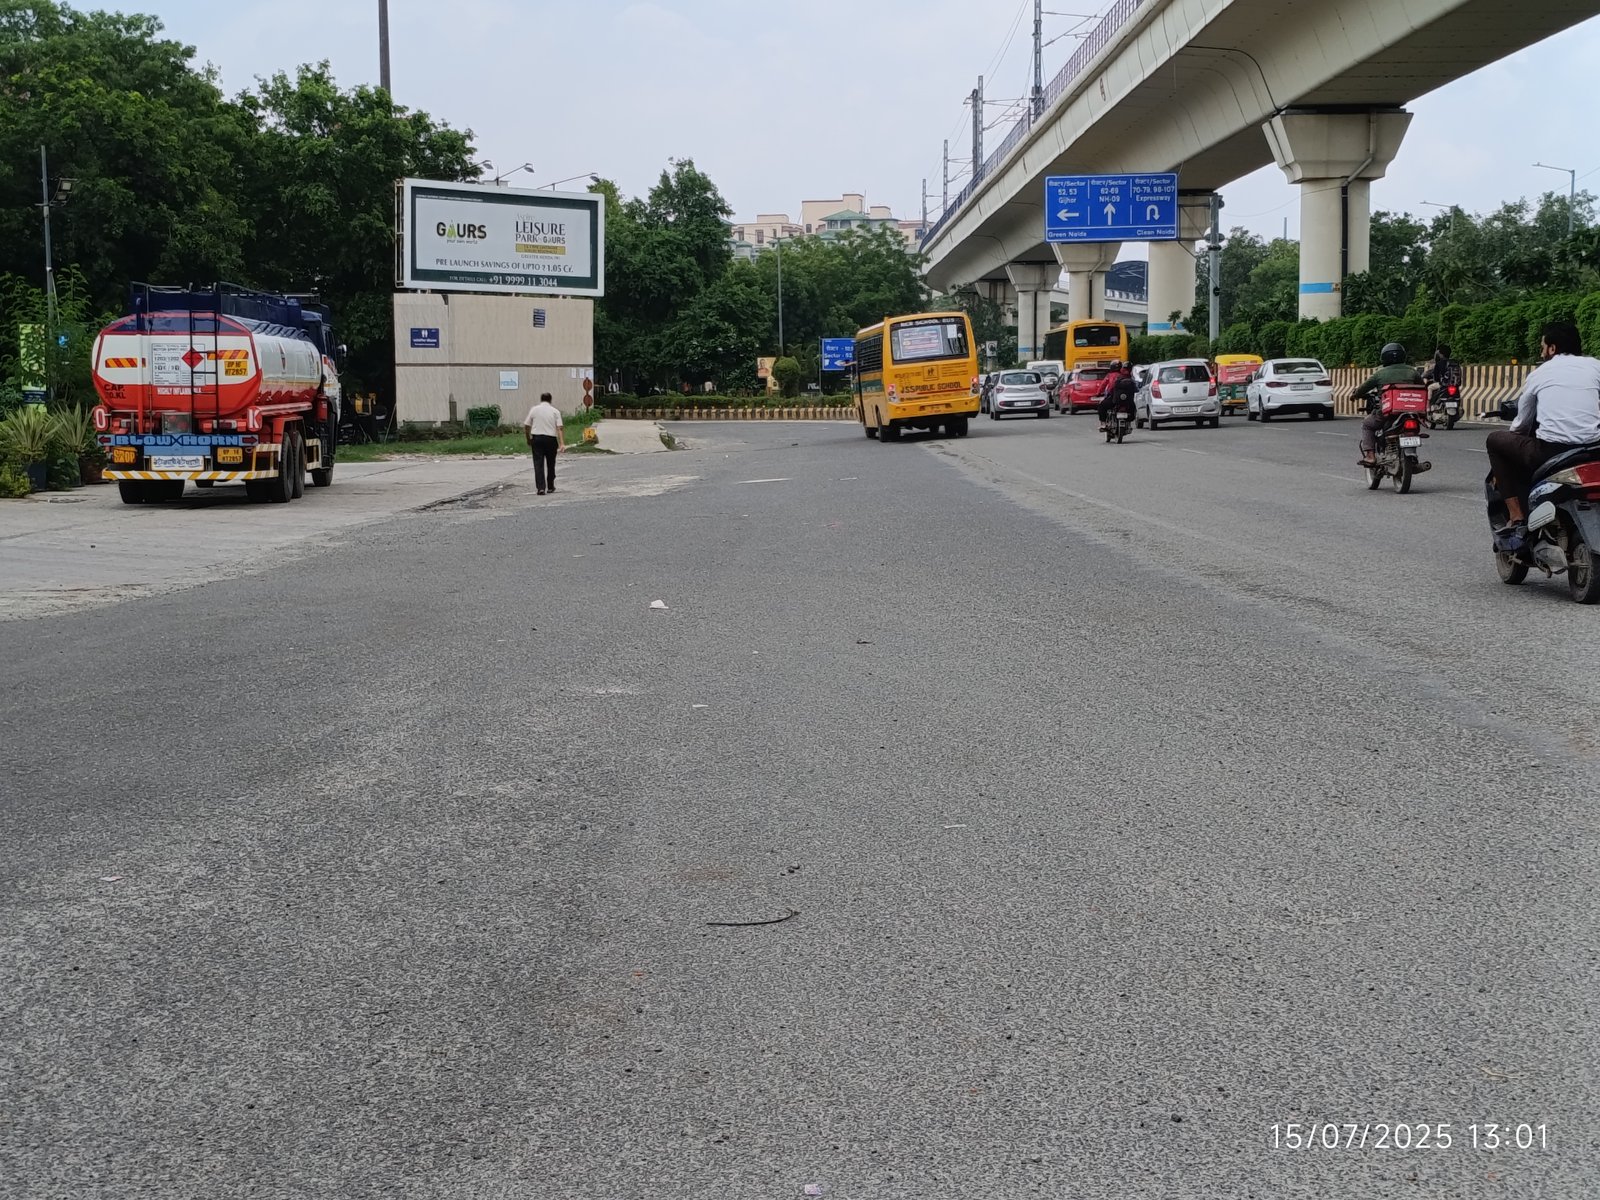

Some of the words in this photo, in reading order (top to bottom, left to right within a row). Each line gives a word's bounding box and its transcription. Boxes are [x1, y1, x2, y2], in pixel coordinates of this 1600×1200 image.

[1099, 195, 1120, 203] NH-09
[436, 219, 487, 240] GAURS
[515, 221, 566, 236] LEISURE
[515, 233, 538, 243] PARK
[436, 258, 447, 266] PRE
[449, 259, 479, 267] LAUNCH
[481, 260, 510, 269] SAVINGS
[511, 262, 520, 270] OF
[522, 262, 540, 271] UPTO
[489, 275, 503, 284] +91
[505, 276, 525, 285] 9999
[527, 277, 536, 286] 11
[538, 277, 558, 287] 3044
[937, 382, 962, 390] SCHOOL
[115, 435, 171, 446] BLOW
[183, 435, 239, 446] HORN
